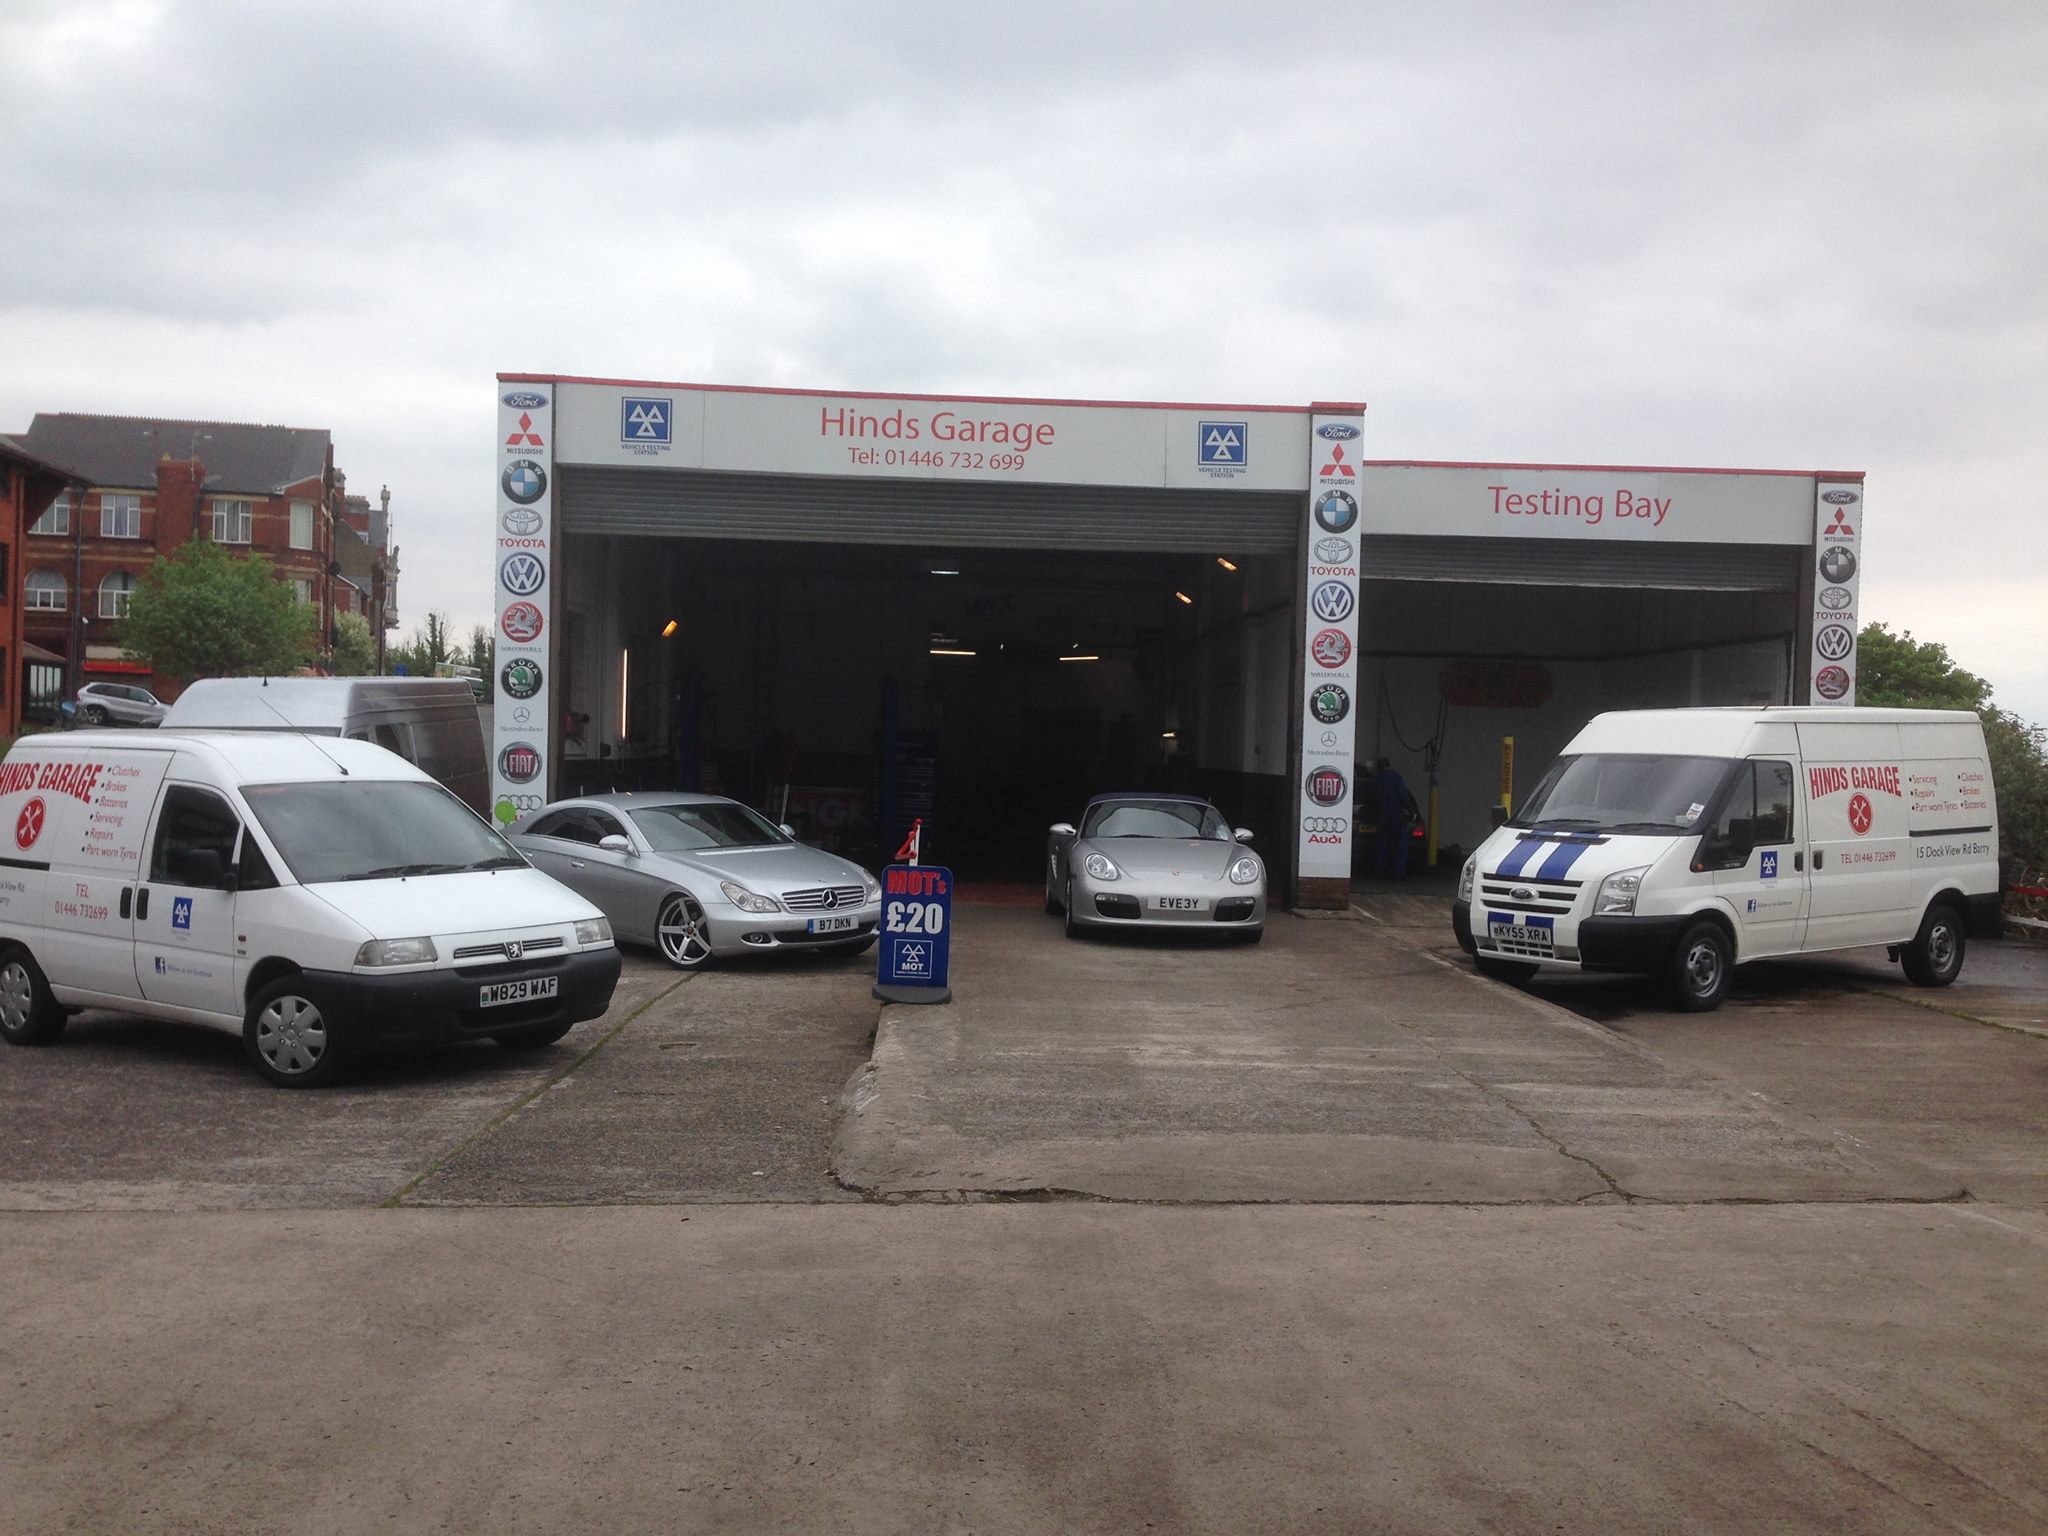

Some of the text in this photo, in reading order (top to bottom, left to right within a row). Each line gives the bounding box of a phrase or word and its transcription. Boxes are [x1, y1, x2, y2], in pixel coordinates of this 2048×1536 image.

[821, 407, 1055, 452] Hinds Garage
[848, 448, 1025, 471] Tel: 01446 732 699
[1488, 486, 1672, 526] Testing Bay
[498, 538, 546, 548] TOYOTA
[1310, 567, 1356, 576] TOYOTA
[1815, 611, 1854, 620] TOYOTA
[508, 754, 533, 773] FIAT
[0, 762, 103, 805] HINDS GARAGE
[1315, 778, 1339, 796] FIAT
[1808, 766, 1902, 800] HINDS GARAGE
[1912, 774, 1938, 786] Servicing
[1914, 788, 1936, 800] Repairs
[1307, 833, 1342, 845] Audi
[1841, 851, 1896, 864] TEL 01446 732699
[1916, 841, 1990, 859] 15 Dock View Rd Barry
[75, 883, 90, 898] TEL
[886, 869, 947, 896] MOT's
[55, 900, 108, 920] 01446 732699
[1160, 897, 1199, 909] EVE3Y
[819, 918, 851, 930] B7 DKN
[886, 901, 943, 935] £20
[1499, 925, 1548, 941] KY55 XRA
[901, 962, 924, 971] MOT
[490, 978, 556, 1002] W829 WAF
